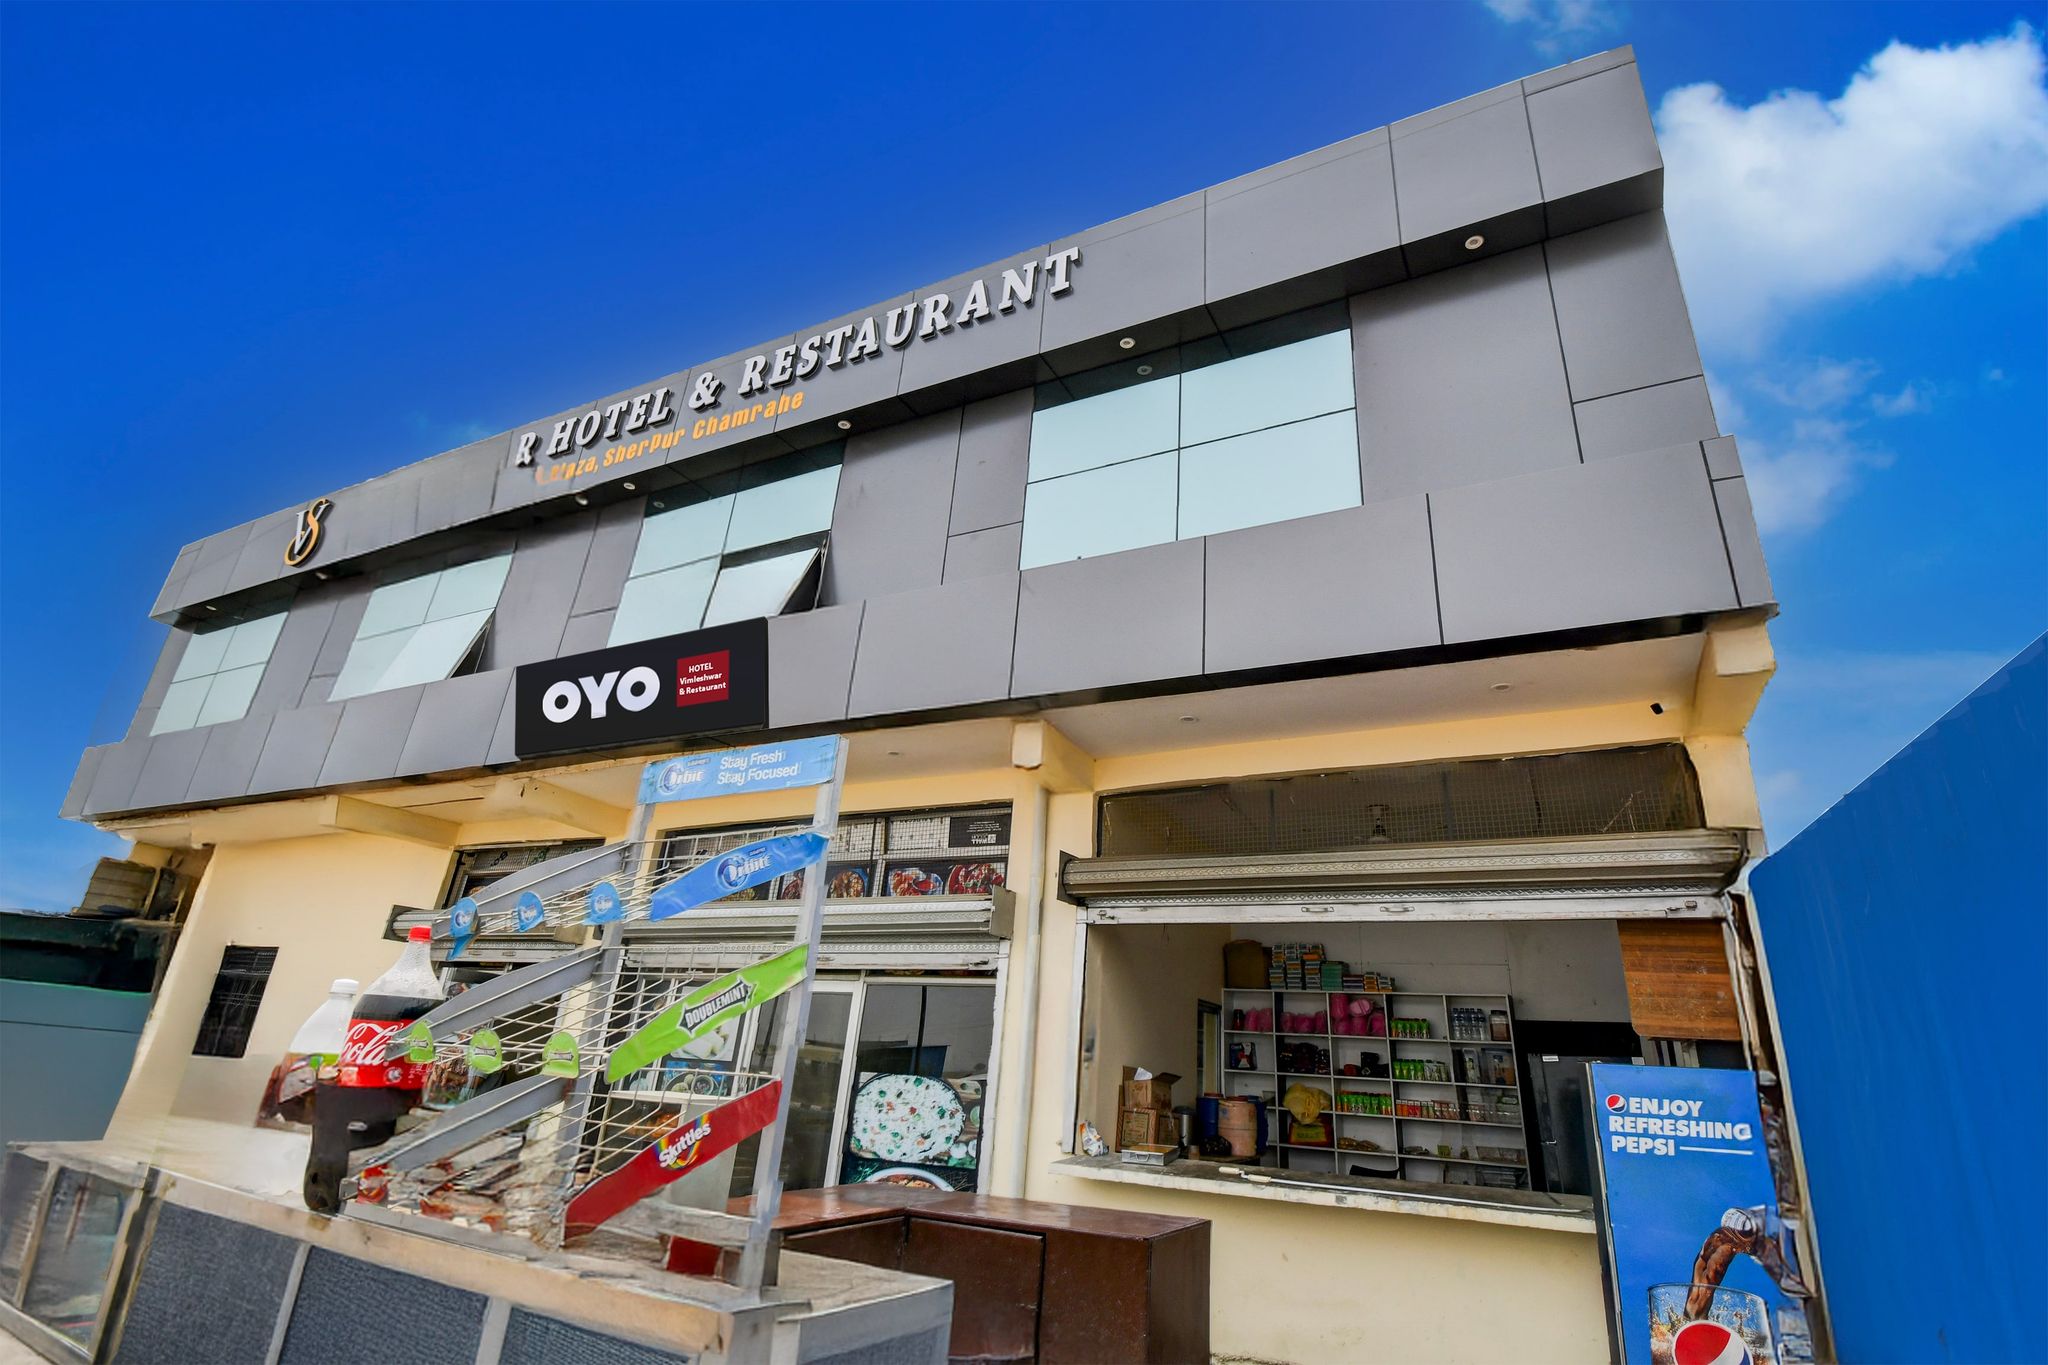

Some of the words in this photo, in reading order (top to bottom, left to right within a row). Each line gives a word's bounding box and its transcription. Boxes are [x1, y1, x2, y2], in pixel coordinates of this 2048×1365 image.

[515, 431, 539, 467] R
[546, 387, 674, 458] HOTEL
[688, 371, 724, 411] &
[738, 246, 1081, 398] RESTAURANT
[692, 391, 804, 440] Chamrahe
[679, 672, 722, 685] Vimleshwar
[688, 662, 713, 673] HOTEL
[542, 665, 661, 724] OYO
[678, 687, 685, 695] &
[685, 681, 726, 694] Restaurant
[720, 756, 748, 770] Stay
[750, 750, 786, 765] Fresh
[717, 771, 745, 786] Stay
[747, 762, 802, 781] Focused
[684, 983, 747, 1029] DOUBLEMINT
[1628, 1096, 1703, 1117] ENJOY
[1608, 1115, 1753, 1141] REFRESHING
[658, 1123, 712, 1168] Skittles
[1611, 1135, 1676, 1157] PEPSI
